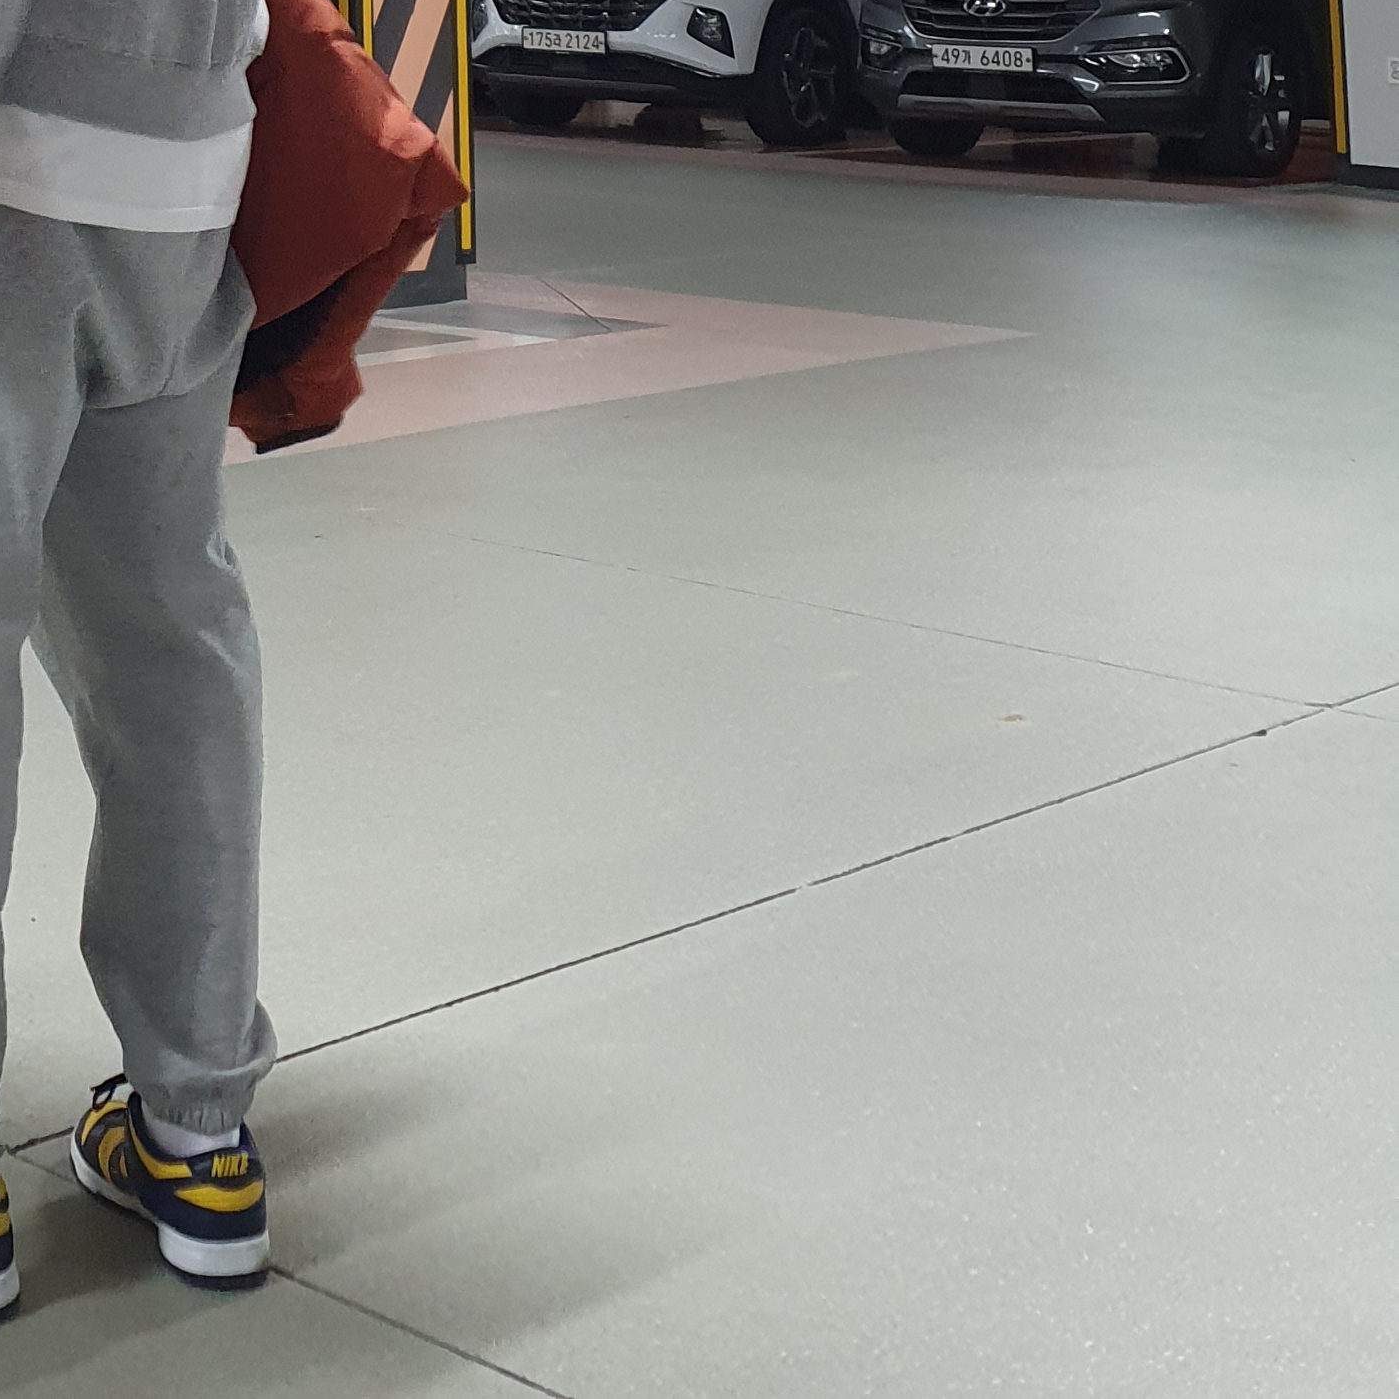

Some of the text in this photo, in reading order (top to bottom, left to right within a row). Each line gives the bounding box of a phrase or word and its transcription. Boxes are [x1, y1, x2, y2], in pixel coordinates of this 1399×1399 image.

[565, 32, 600, 51] 2124
[980, 49, 1024, 68] 6408
[211, 1151, 249, 1178] NIKE
